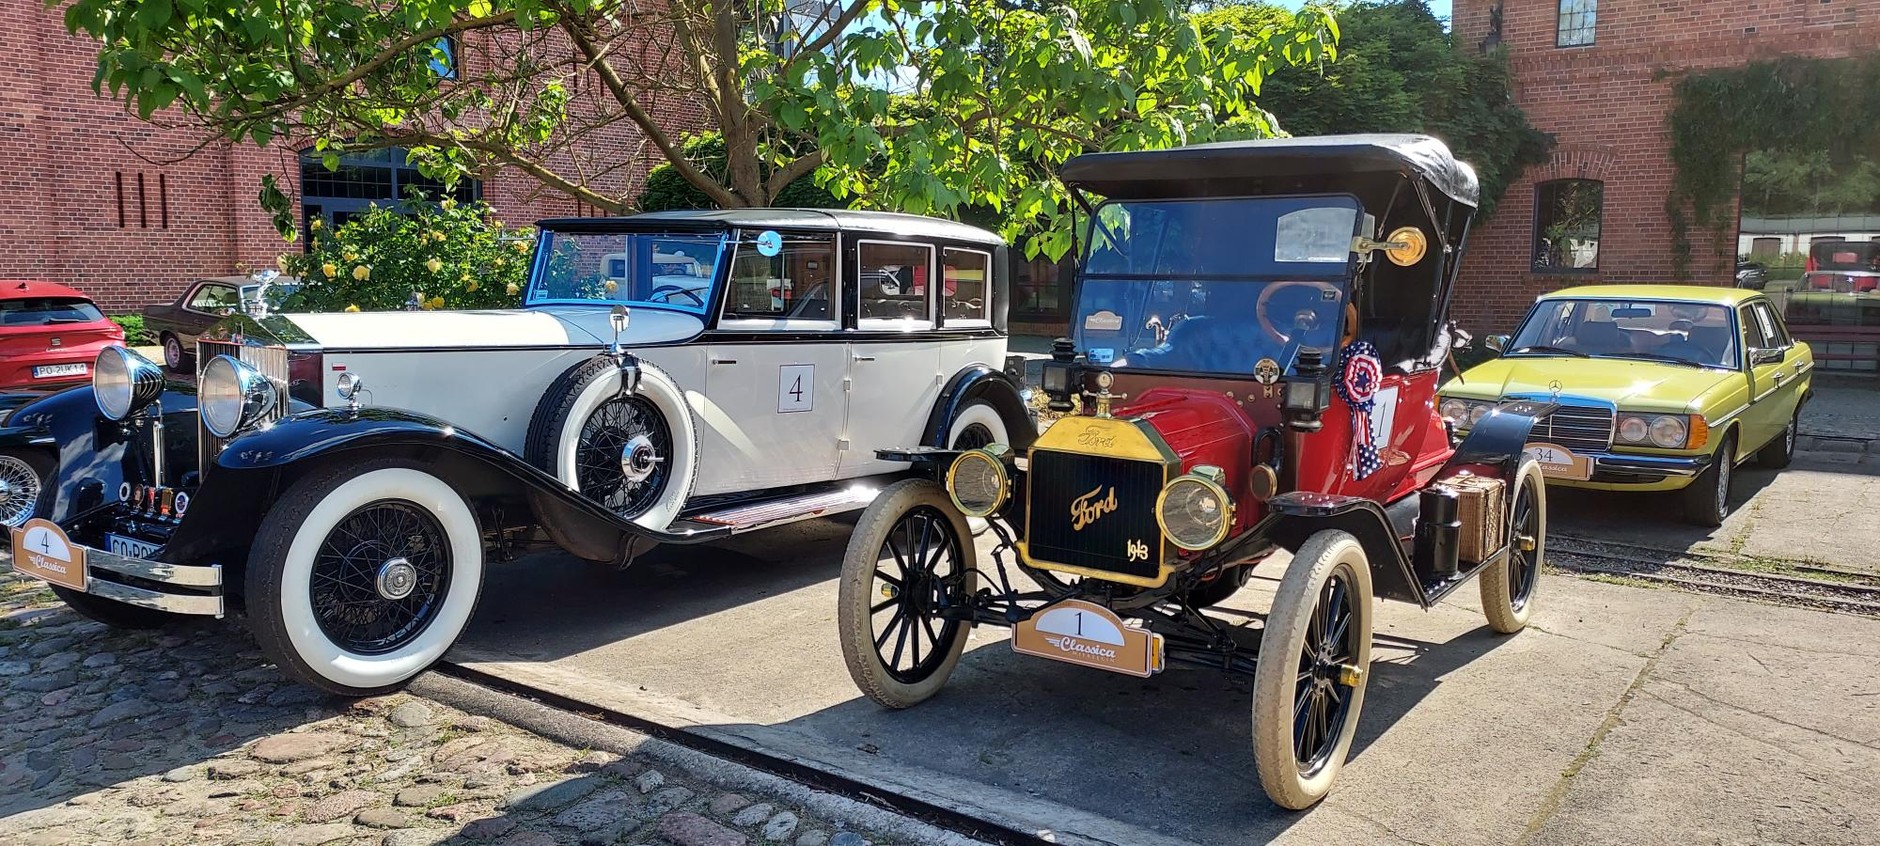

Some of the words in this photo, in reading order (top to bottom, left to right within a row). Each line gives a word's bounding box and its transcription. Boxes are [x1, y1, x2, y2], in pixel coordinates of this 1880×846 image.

[788, 373, 804, 402] 4
[1376, 401, 1387, 438] 1
[1077, 425, 1117, 448] Ford
[1534, 447, 1554, 462] 34
[1070, 484, 1118, 531] Ford
[41, 531, 49, 554] 4
[1127, 539, 1149, 562] 1913
[35, 554, 67, 574] Classica
[1074, 612, 1083, 636] 1
[1060, 637, 1117, 658] Classica
